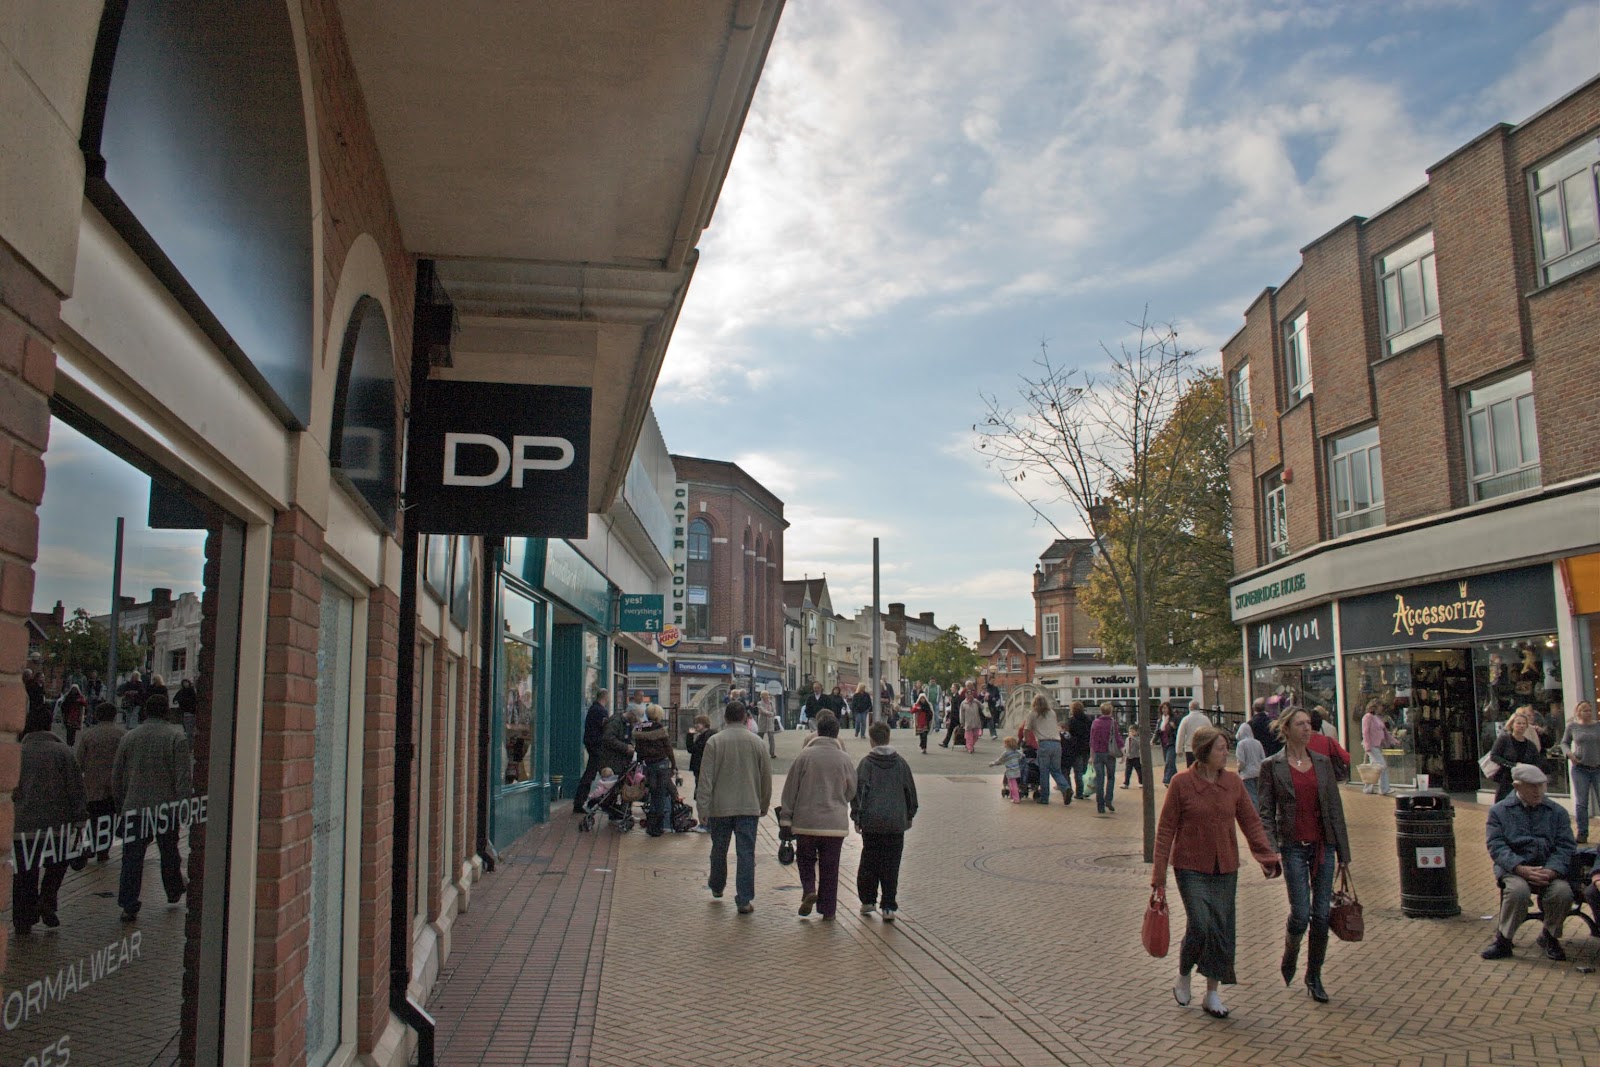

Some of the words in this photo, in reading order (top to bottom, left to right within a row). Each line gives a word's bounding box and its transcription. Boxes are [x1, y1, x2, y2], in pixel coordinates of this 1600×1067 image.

[443, 432, 575, 488] DP
[674, 488, 686, 549] CATER
[624, 596, 643, 605] yes!
[1235, 582, 1280, 610] STONEBRIDGE
[1281, 573, 1306, 596] HOUSE
[623, 607, 662, 616] everything's
[645, 618, 660, 630] £1
[1392, 594, 1485, 635] Accessorize
[660, 633, 679, 643] KING
[1259, 618, 1319, 660] Monsoon
[23, 1035, 70, 1067] ES
